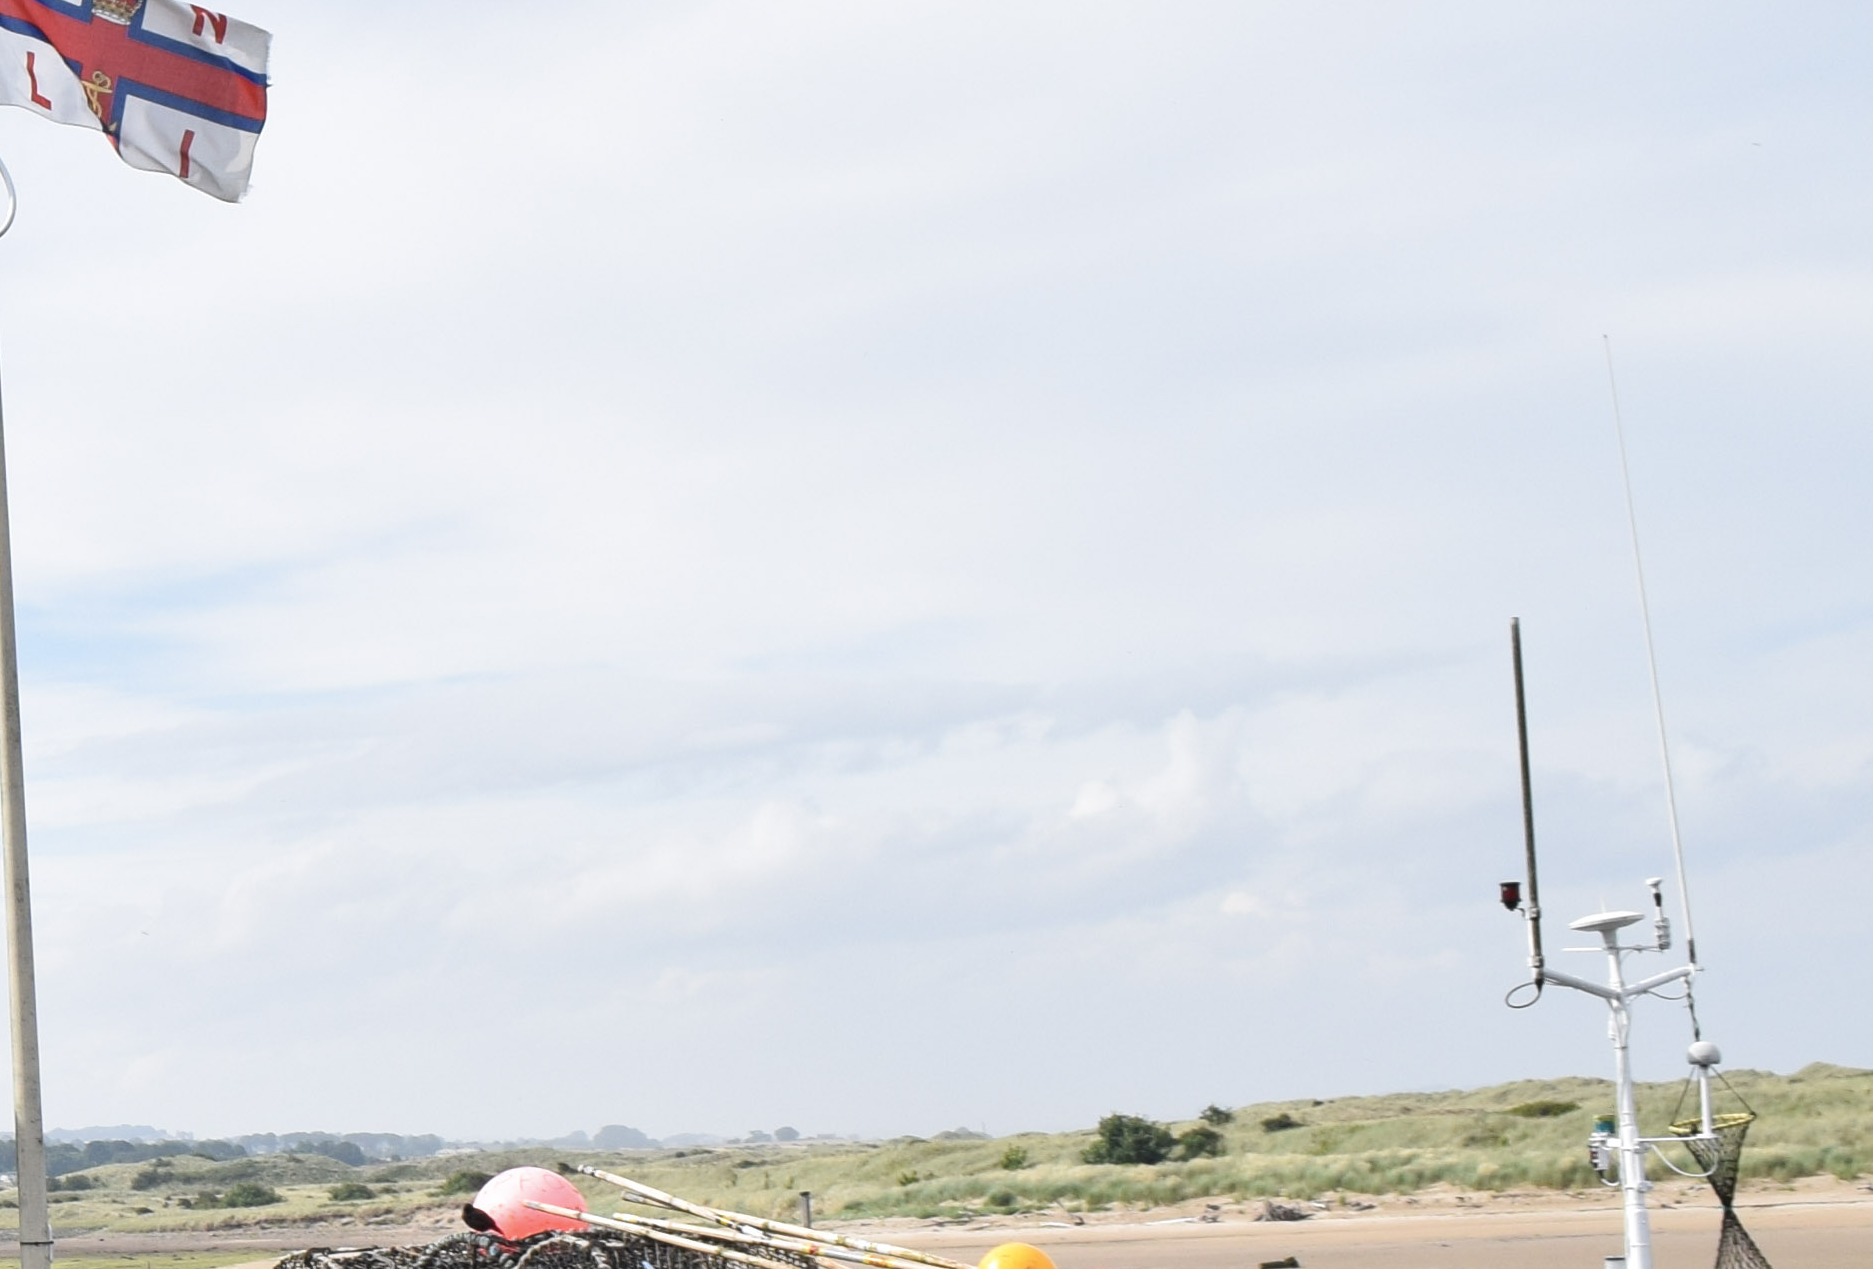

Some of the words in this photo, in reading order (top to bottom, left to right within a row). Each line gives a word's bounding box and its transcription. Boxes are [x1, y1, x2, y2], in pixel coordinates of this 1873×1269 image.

[190, 4, 228, 44] N
[27, 52, 52, 110] L
[180, 130, 195, 178] I
